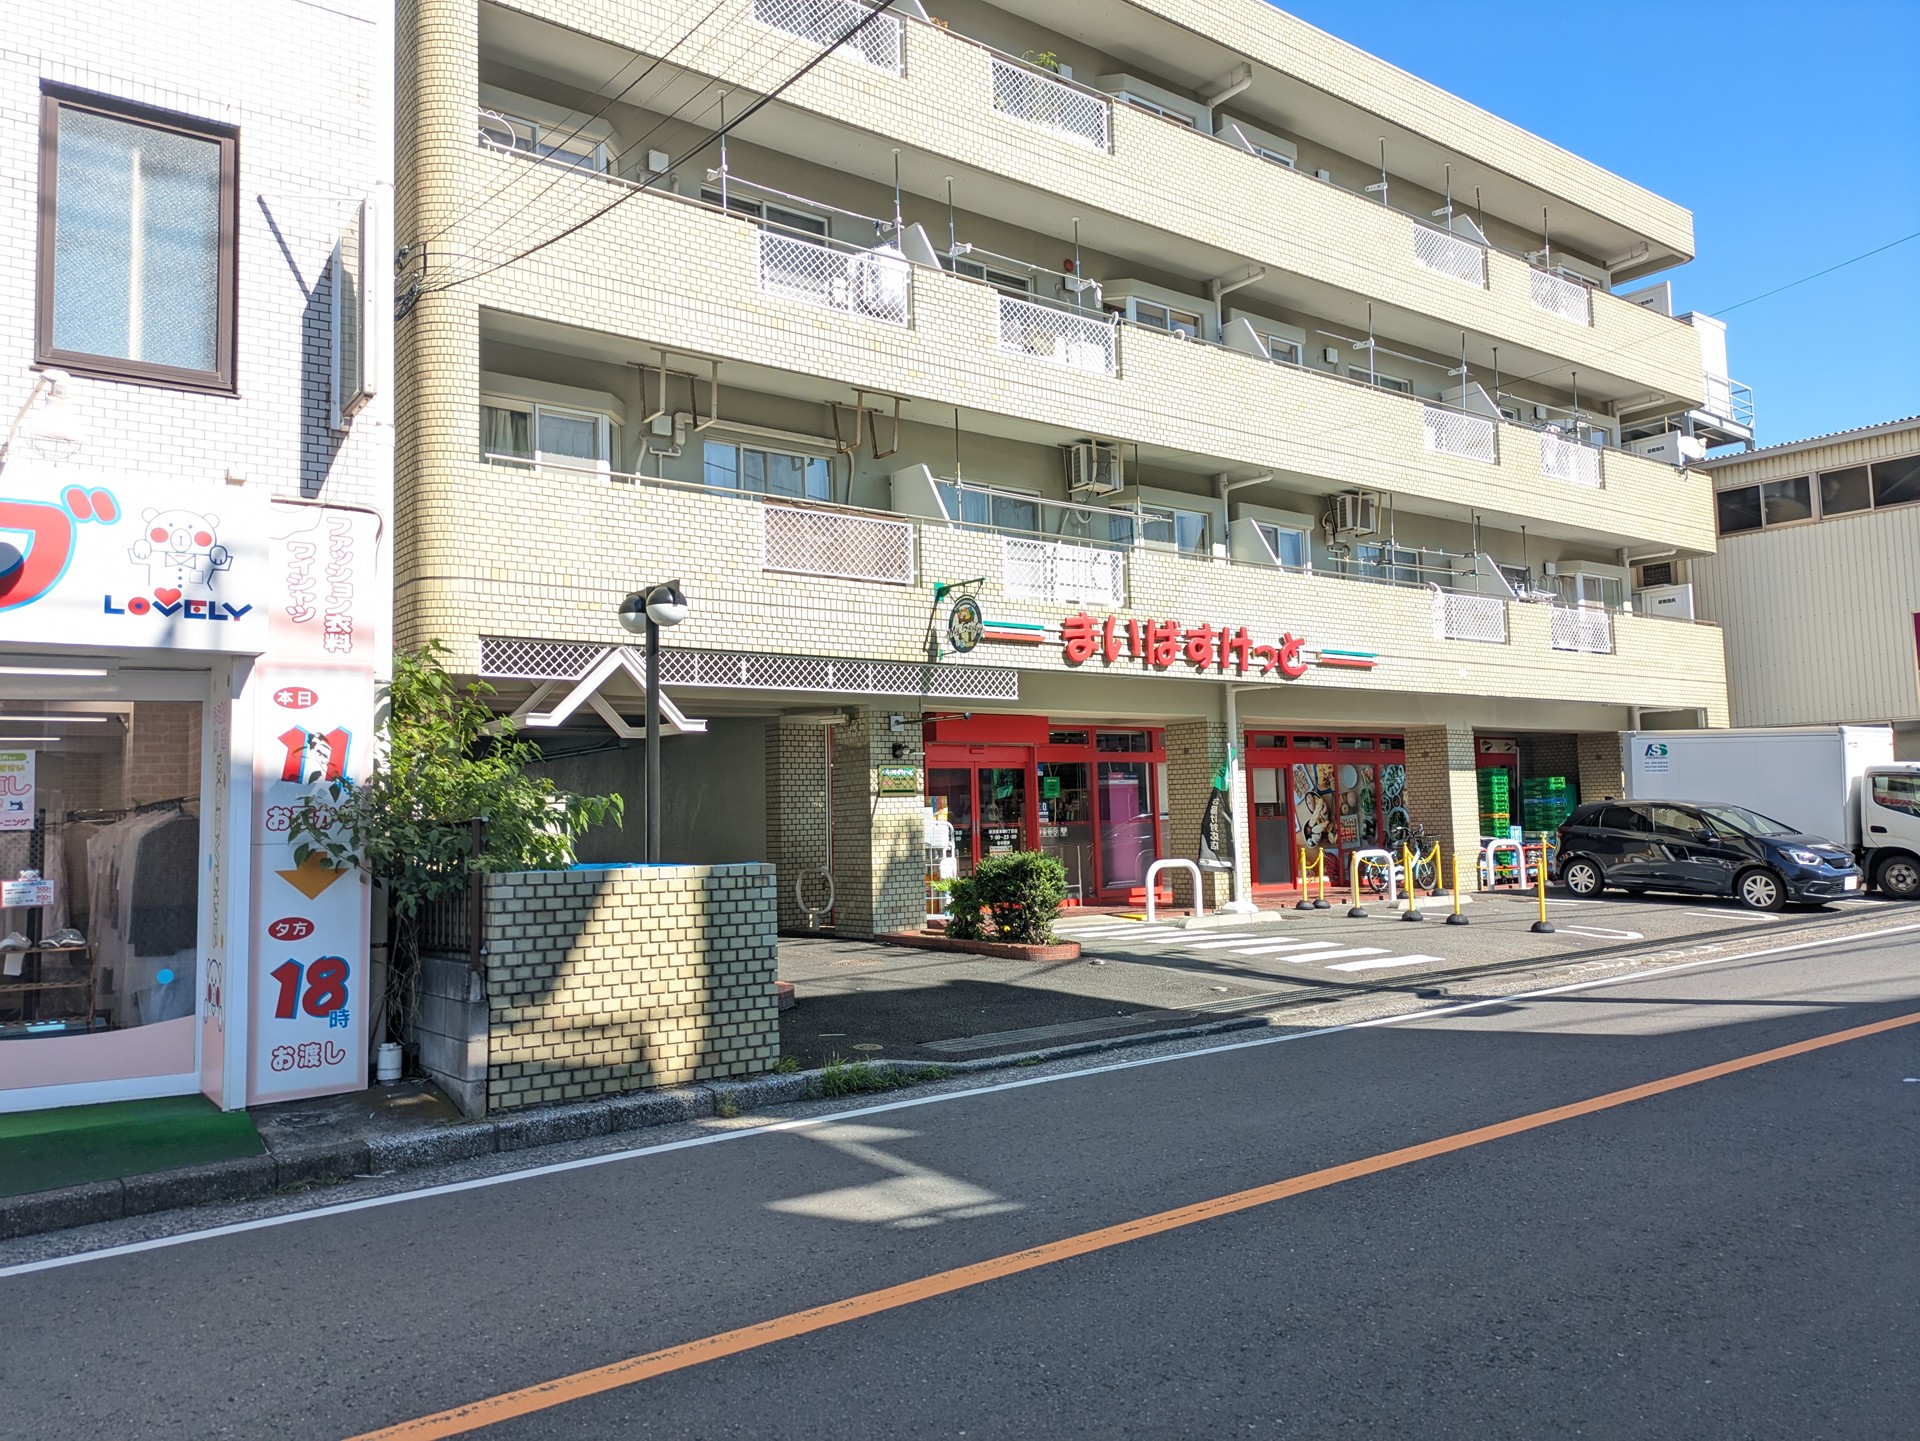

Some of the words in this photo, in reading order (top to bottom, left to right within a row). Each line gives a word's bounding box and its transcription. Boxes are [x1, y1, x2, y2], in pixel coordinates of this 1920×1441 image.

[286, 541, 317, 624] ワイシャツ
[324, 516, 354, 654] ファッション衣料
[104, 594, 253, 622] LOVELY
[1063, 612, 1308, 676] まいばすけっと
[277, 690, 312, 706] 本日
[276, 922, 307, 937] 夕方
[270, 956, 350, 1028] 18時
[271, 1041, 346, 1072] お渡し
